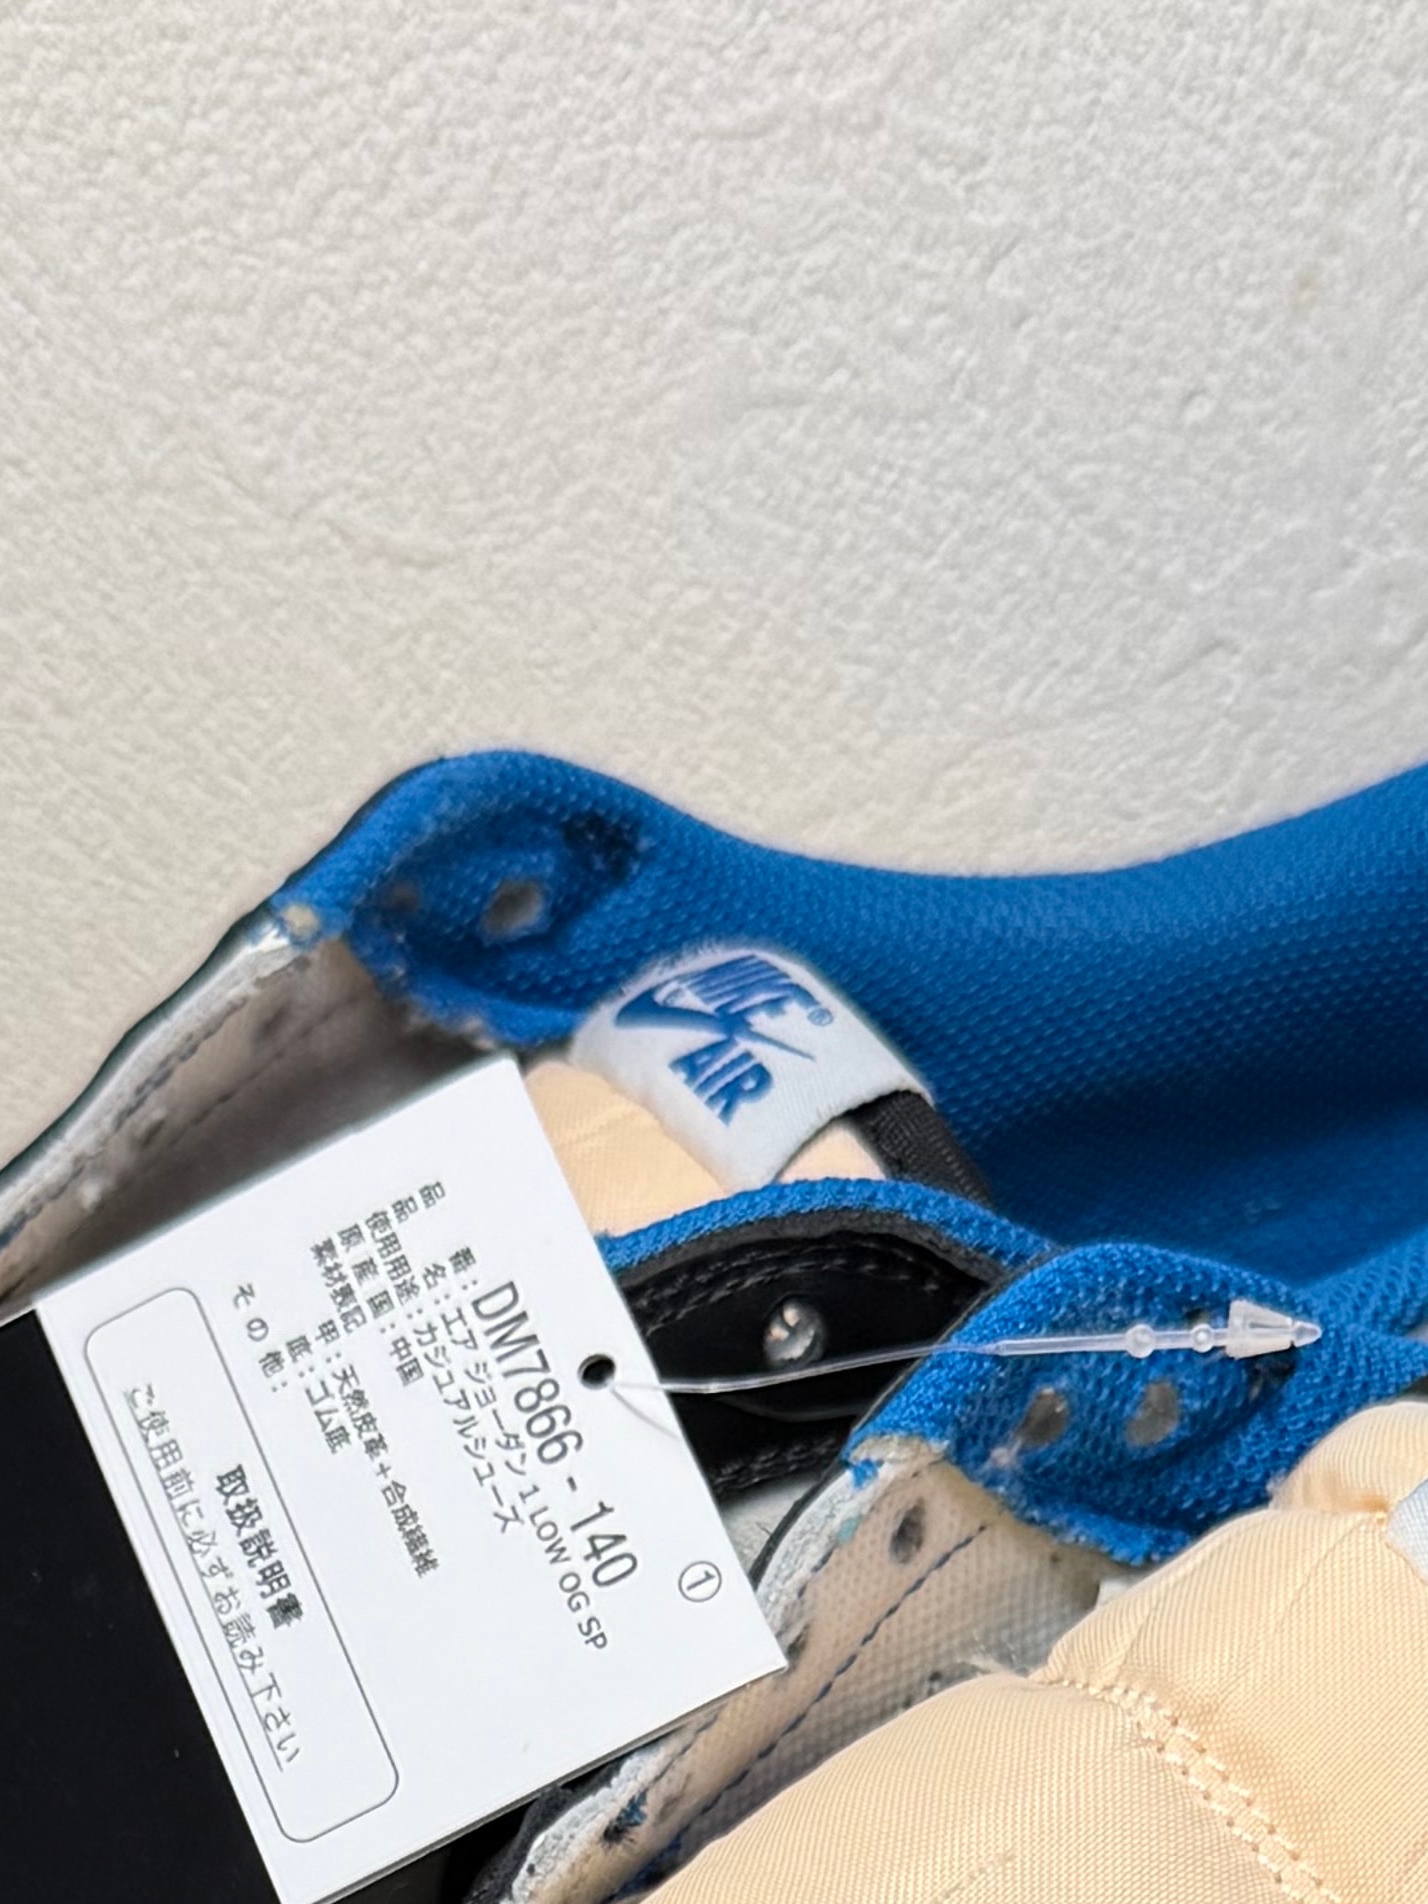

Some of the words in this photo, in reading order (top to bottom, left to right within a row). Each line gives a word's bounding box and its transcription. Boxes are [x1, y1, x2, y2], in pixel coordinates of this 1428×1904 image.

[669, 1038, 772, 1126] AIR
[680, 954, 821, 1022] NIKE
[216, 1464, 303, 1629] 取扱説明書
[440, 1307, 478, 1350] エア
[464, 1362, 526, 1475] ジョーダン
[529, 1506, 571, 1564] LOW
[559, 1572, 590, 1613] OG
[578, 1616, 607, 1649] SP
[471, 1281, 583, 1464] DM7866
[570, 1501, 637, 1587] 140
[124, 1384, 299, 1771] ご使用前に必ずお読み下さい
